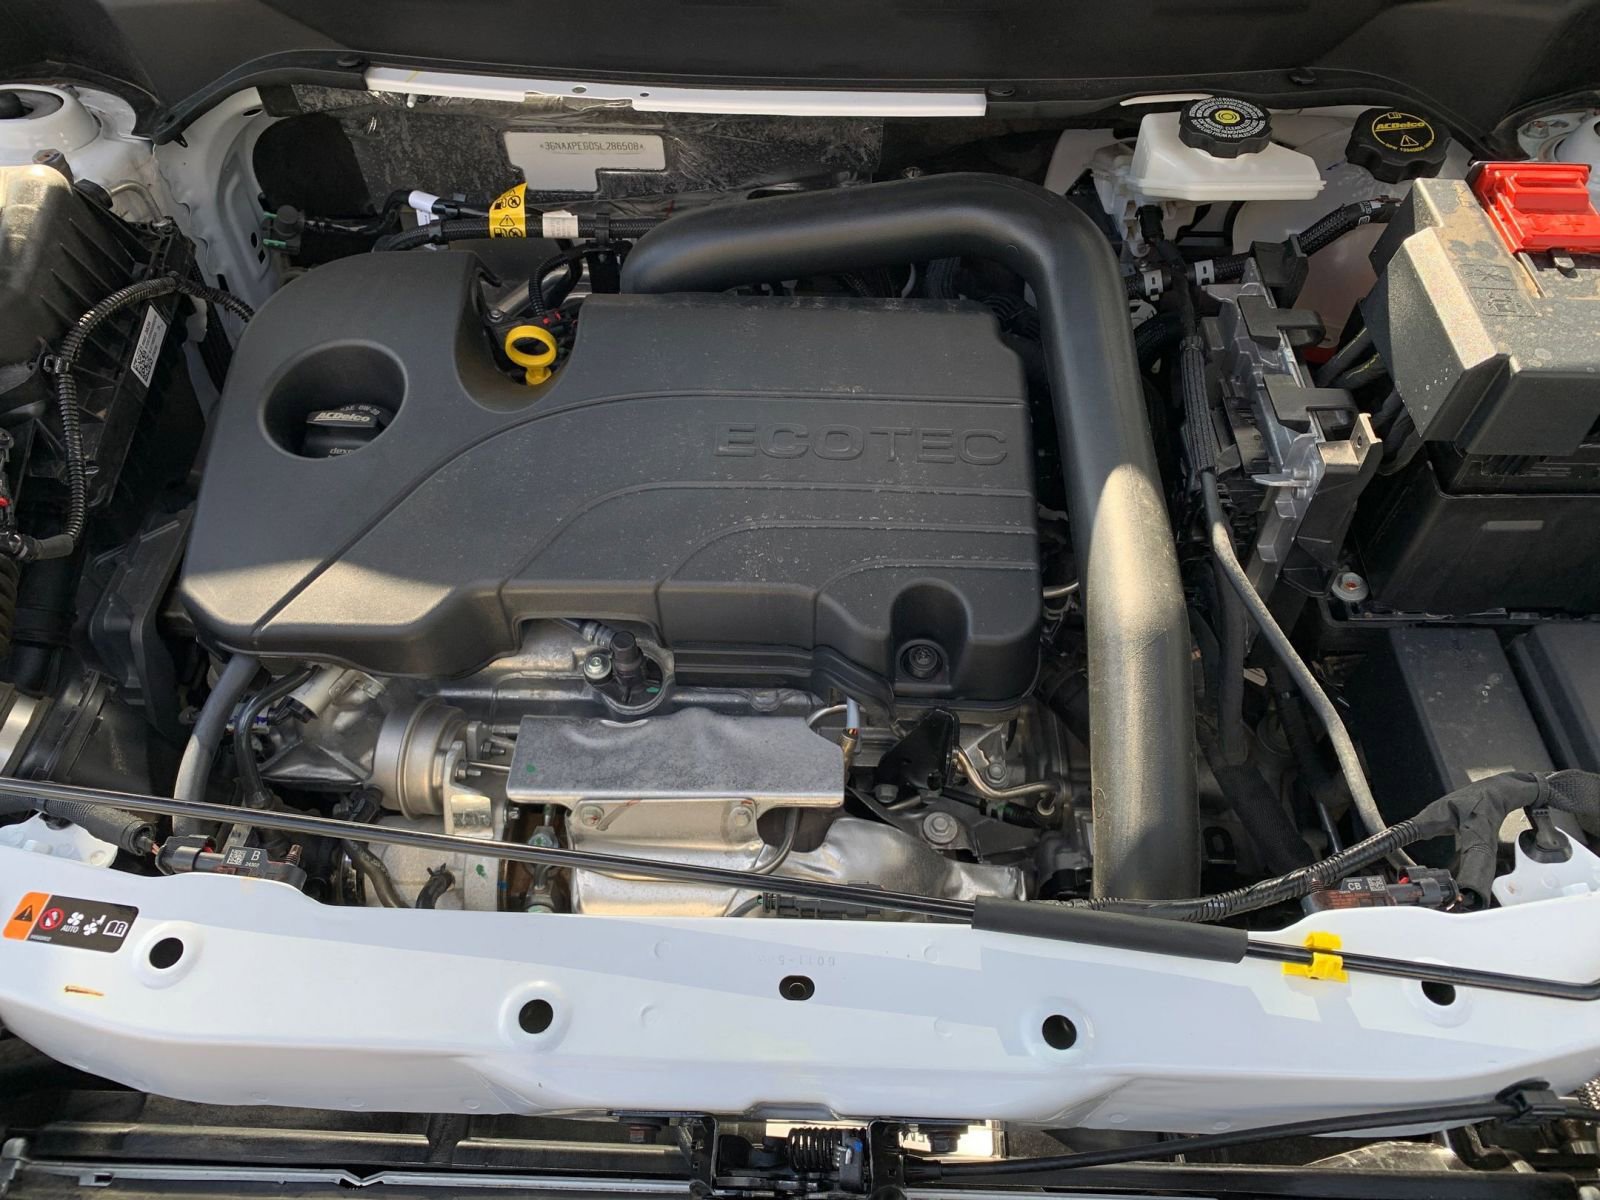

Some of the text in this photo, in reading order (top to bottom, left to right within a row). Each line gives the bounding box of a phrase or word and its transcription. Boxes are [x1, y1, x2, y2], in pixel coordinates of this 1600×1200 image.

[1375, 121, 1426, 130] ACDelco
[313, 412, 370, 422] ACDelco
[712, 422, 1008, 466] ECOTEC
[251, 850, 261, 861] B
[1347, 882, 1362, 891] CB
[60, 924, 80, 933] AUTO
